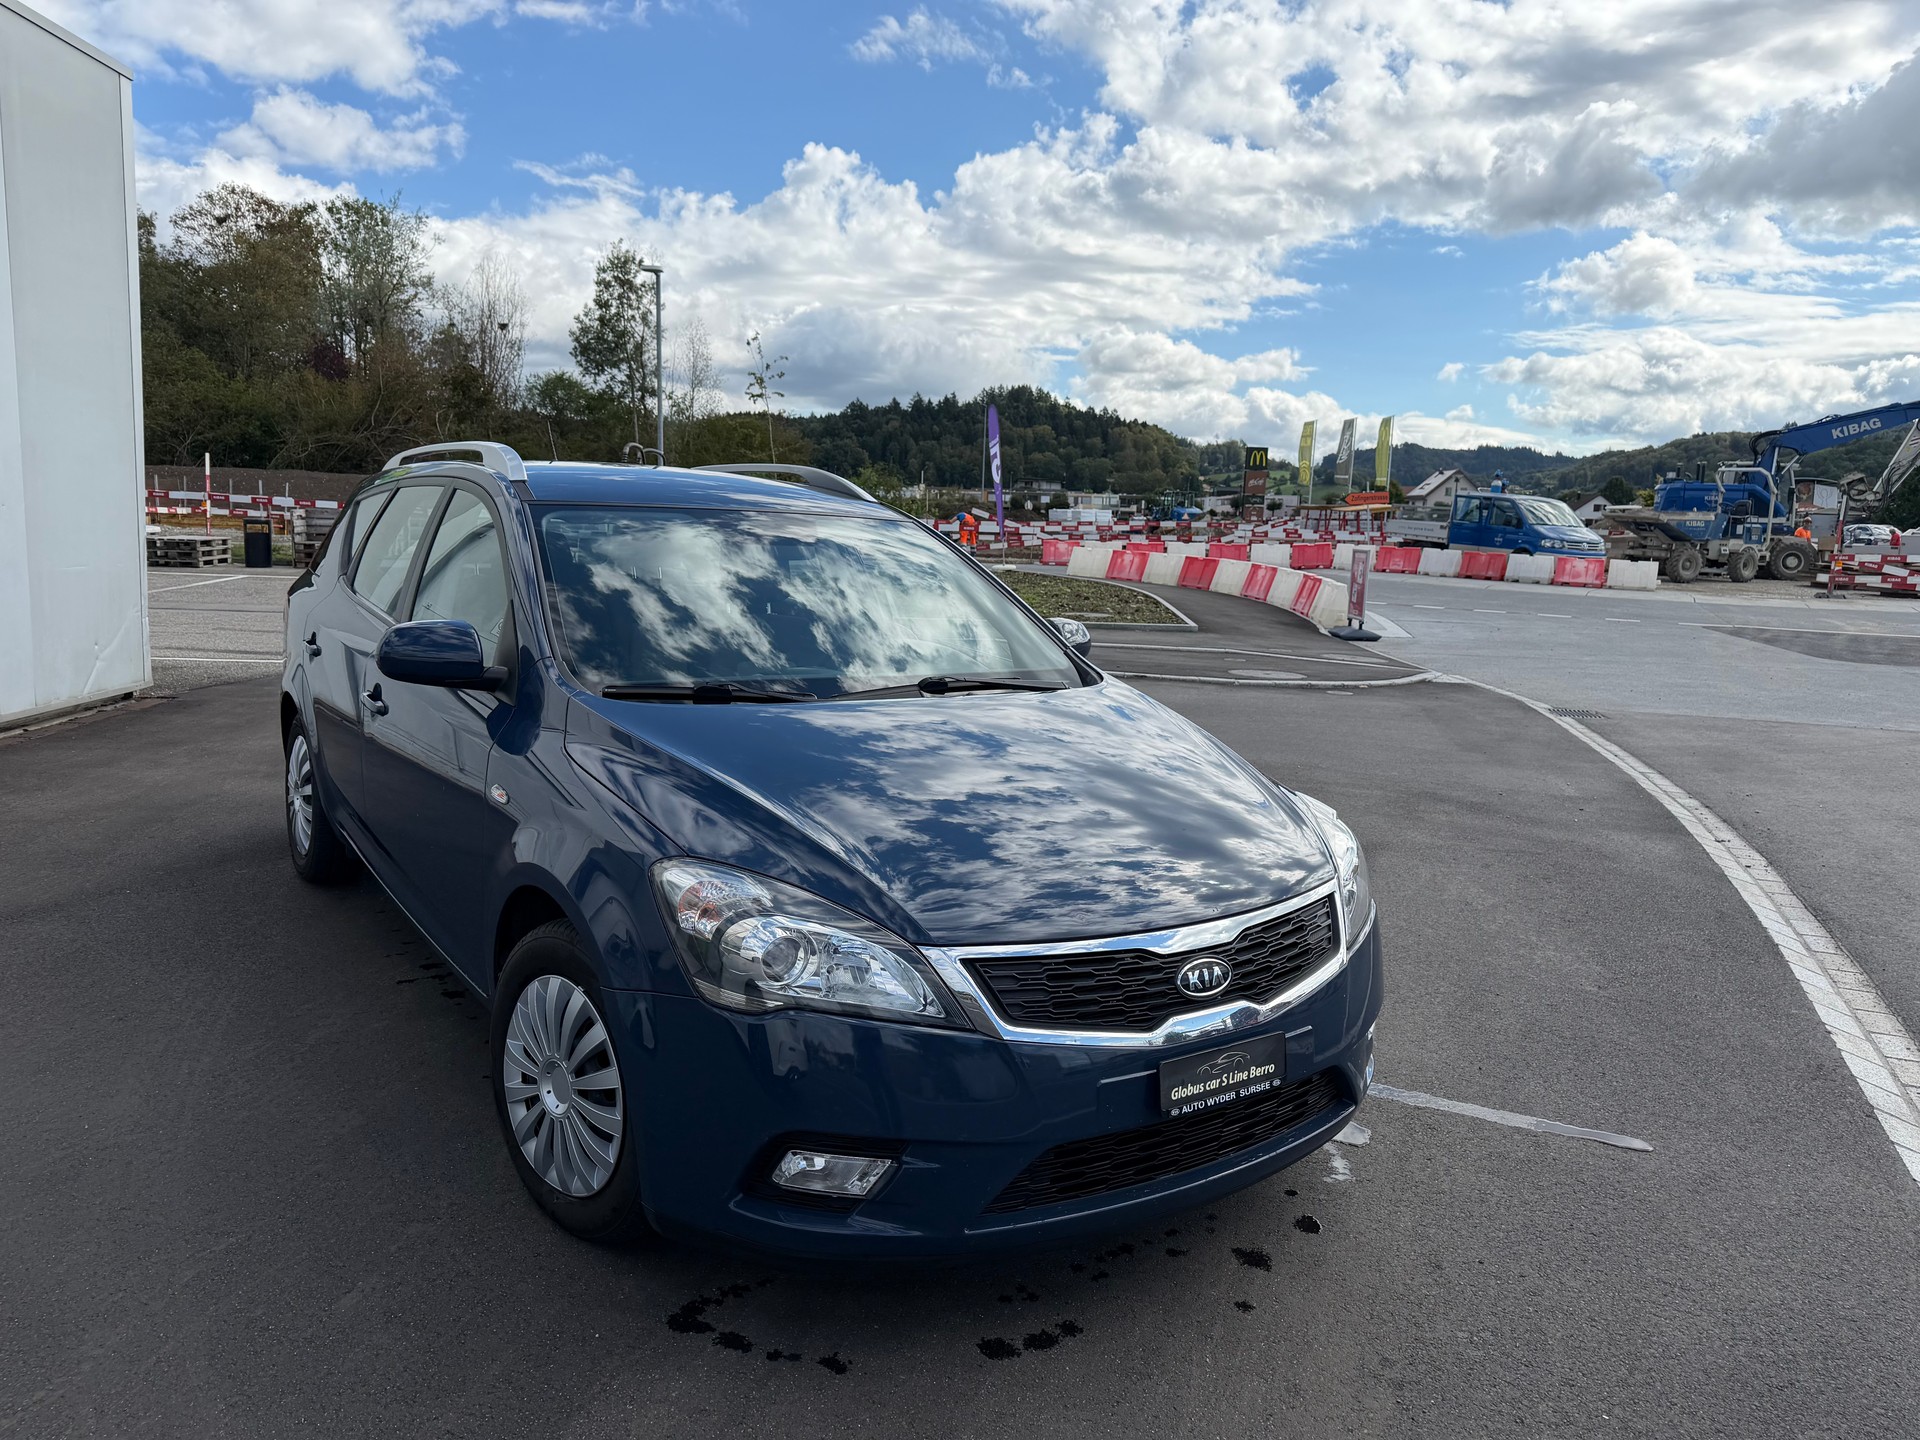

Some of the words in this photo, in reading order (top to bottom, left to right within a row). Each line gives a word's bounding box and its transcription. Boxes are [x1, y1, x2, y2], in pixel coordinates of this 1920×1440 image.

[1831, 418, 1881, 439] KIBAG
[1186, 966, 1225, 991] KIA
[1171, 1081, 1204, 1100] Globus
[1205, 1077, 1221, 1091] car
[1222, 1074, 1228, 1086] S
[1229, 1069, 1248, 1084] Line
[1250, 1063, 1275, 1079] Berro
[1182, 1100, 1205, 1114] AUTO
[1206, 1091, 1236, 1107] WYDER
[1239, 1081, 1271, 1097] SURSEE
